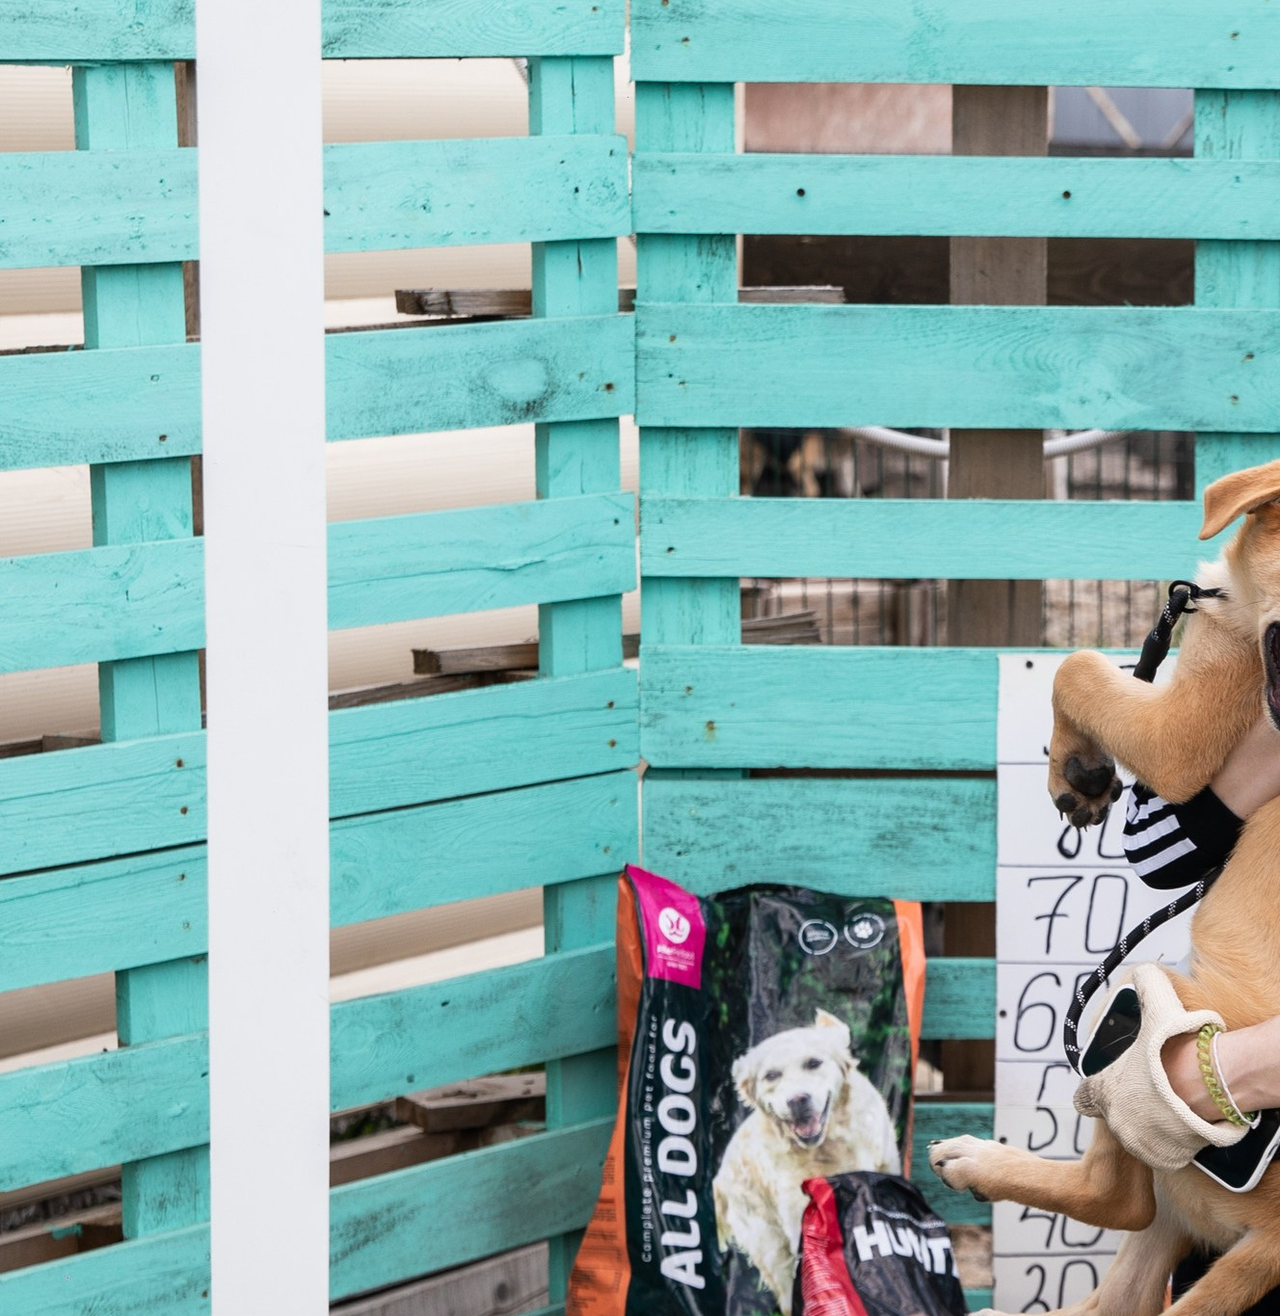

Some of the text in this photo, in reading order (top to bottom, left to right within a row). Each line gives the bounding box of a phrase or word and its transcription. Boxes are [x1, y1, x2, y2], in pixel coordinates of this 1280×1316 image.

[1027, 874, 1128, 956] 70
[644, 1086, 655, 1112] pet
[656, 1017, 698, 1177] DOGS
[641, 1117, 655, 1183] premium
[641, 1187, 654, 1263] Complete
[660, 1188, 707, 1290] ALL
